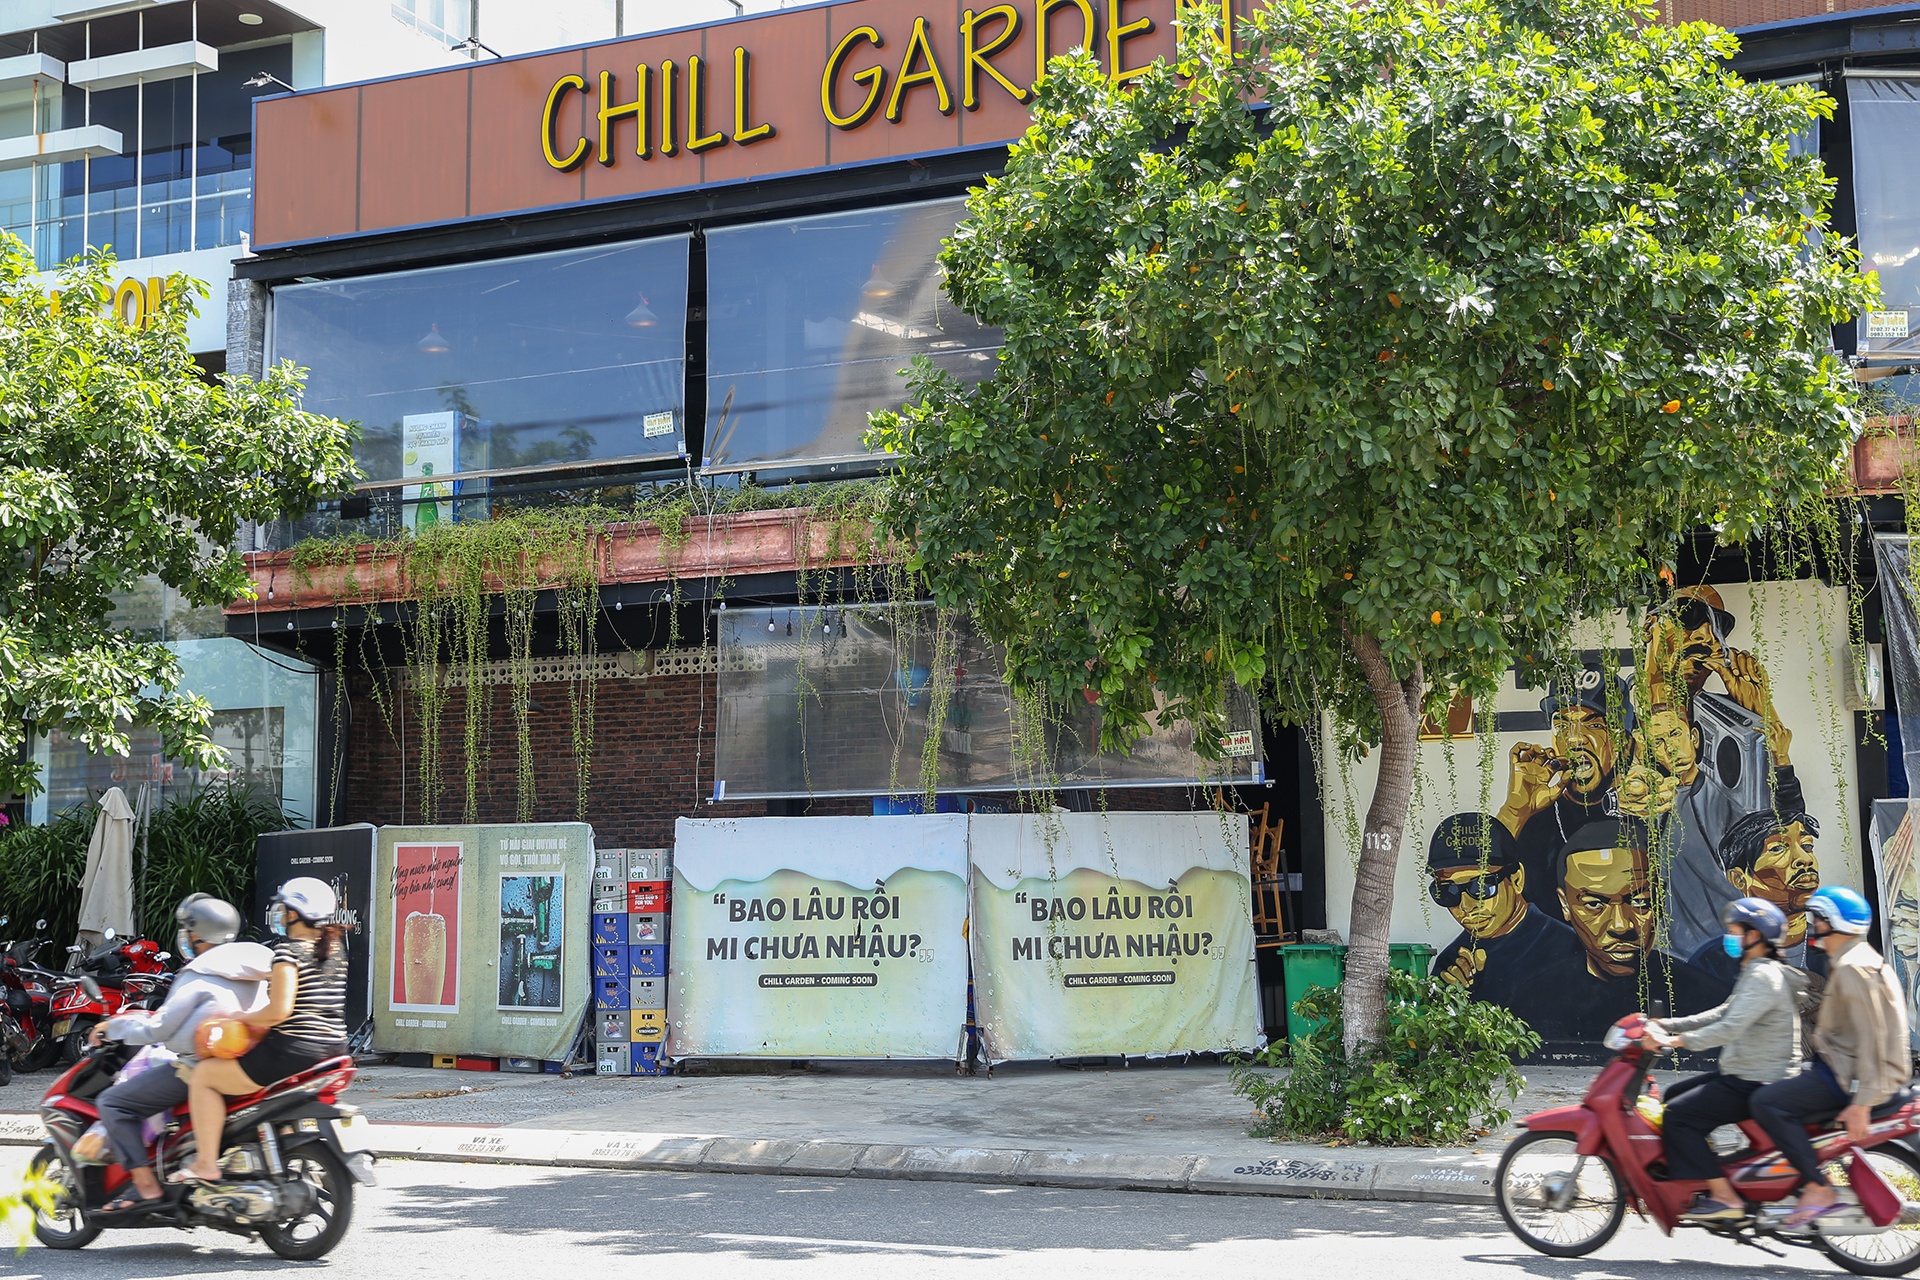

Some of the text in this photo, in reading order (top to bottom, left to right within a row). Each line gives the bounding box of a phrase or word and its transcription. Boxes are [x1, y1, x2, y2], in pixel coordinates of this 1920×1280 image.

[541, 0, 1240, 173] CHILL GARDEN
[1365, 832, 1392, 850] 113
[1446, 836, 1484, 848] GARDE
[792, 886, 845, 921] LÂU
[852, 878, 900, 920] RỒI
[1092, 886, 1142, 920] LÂU
[1148, 878, 1193, 918] RỒI
[706, 936, 738, 960] MI
[744, 932, 820, 960] CHƯA
[1012, 936, 1042, 960] MI
[1048, 932, 1120, 960] CHƯA
[764, 976, 784, 986] CHILL
[784, 976, 815, 986] GARDEN
[821, 976, 850, 985] COMING
[852, 976, 873, 984] SOON
[1068, 976, 1088, 985] CHILL
[1088, 975, 1118, 984] GARDEN
[1123, 974, 1151, 984] COMING
[1152, 974, 1172, 982] SOON
